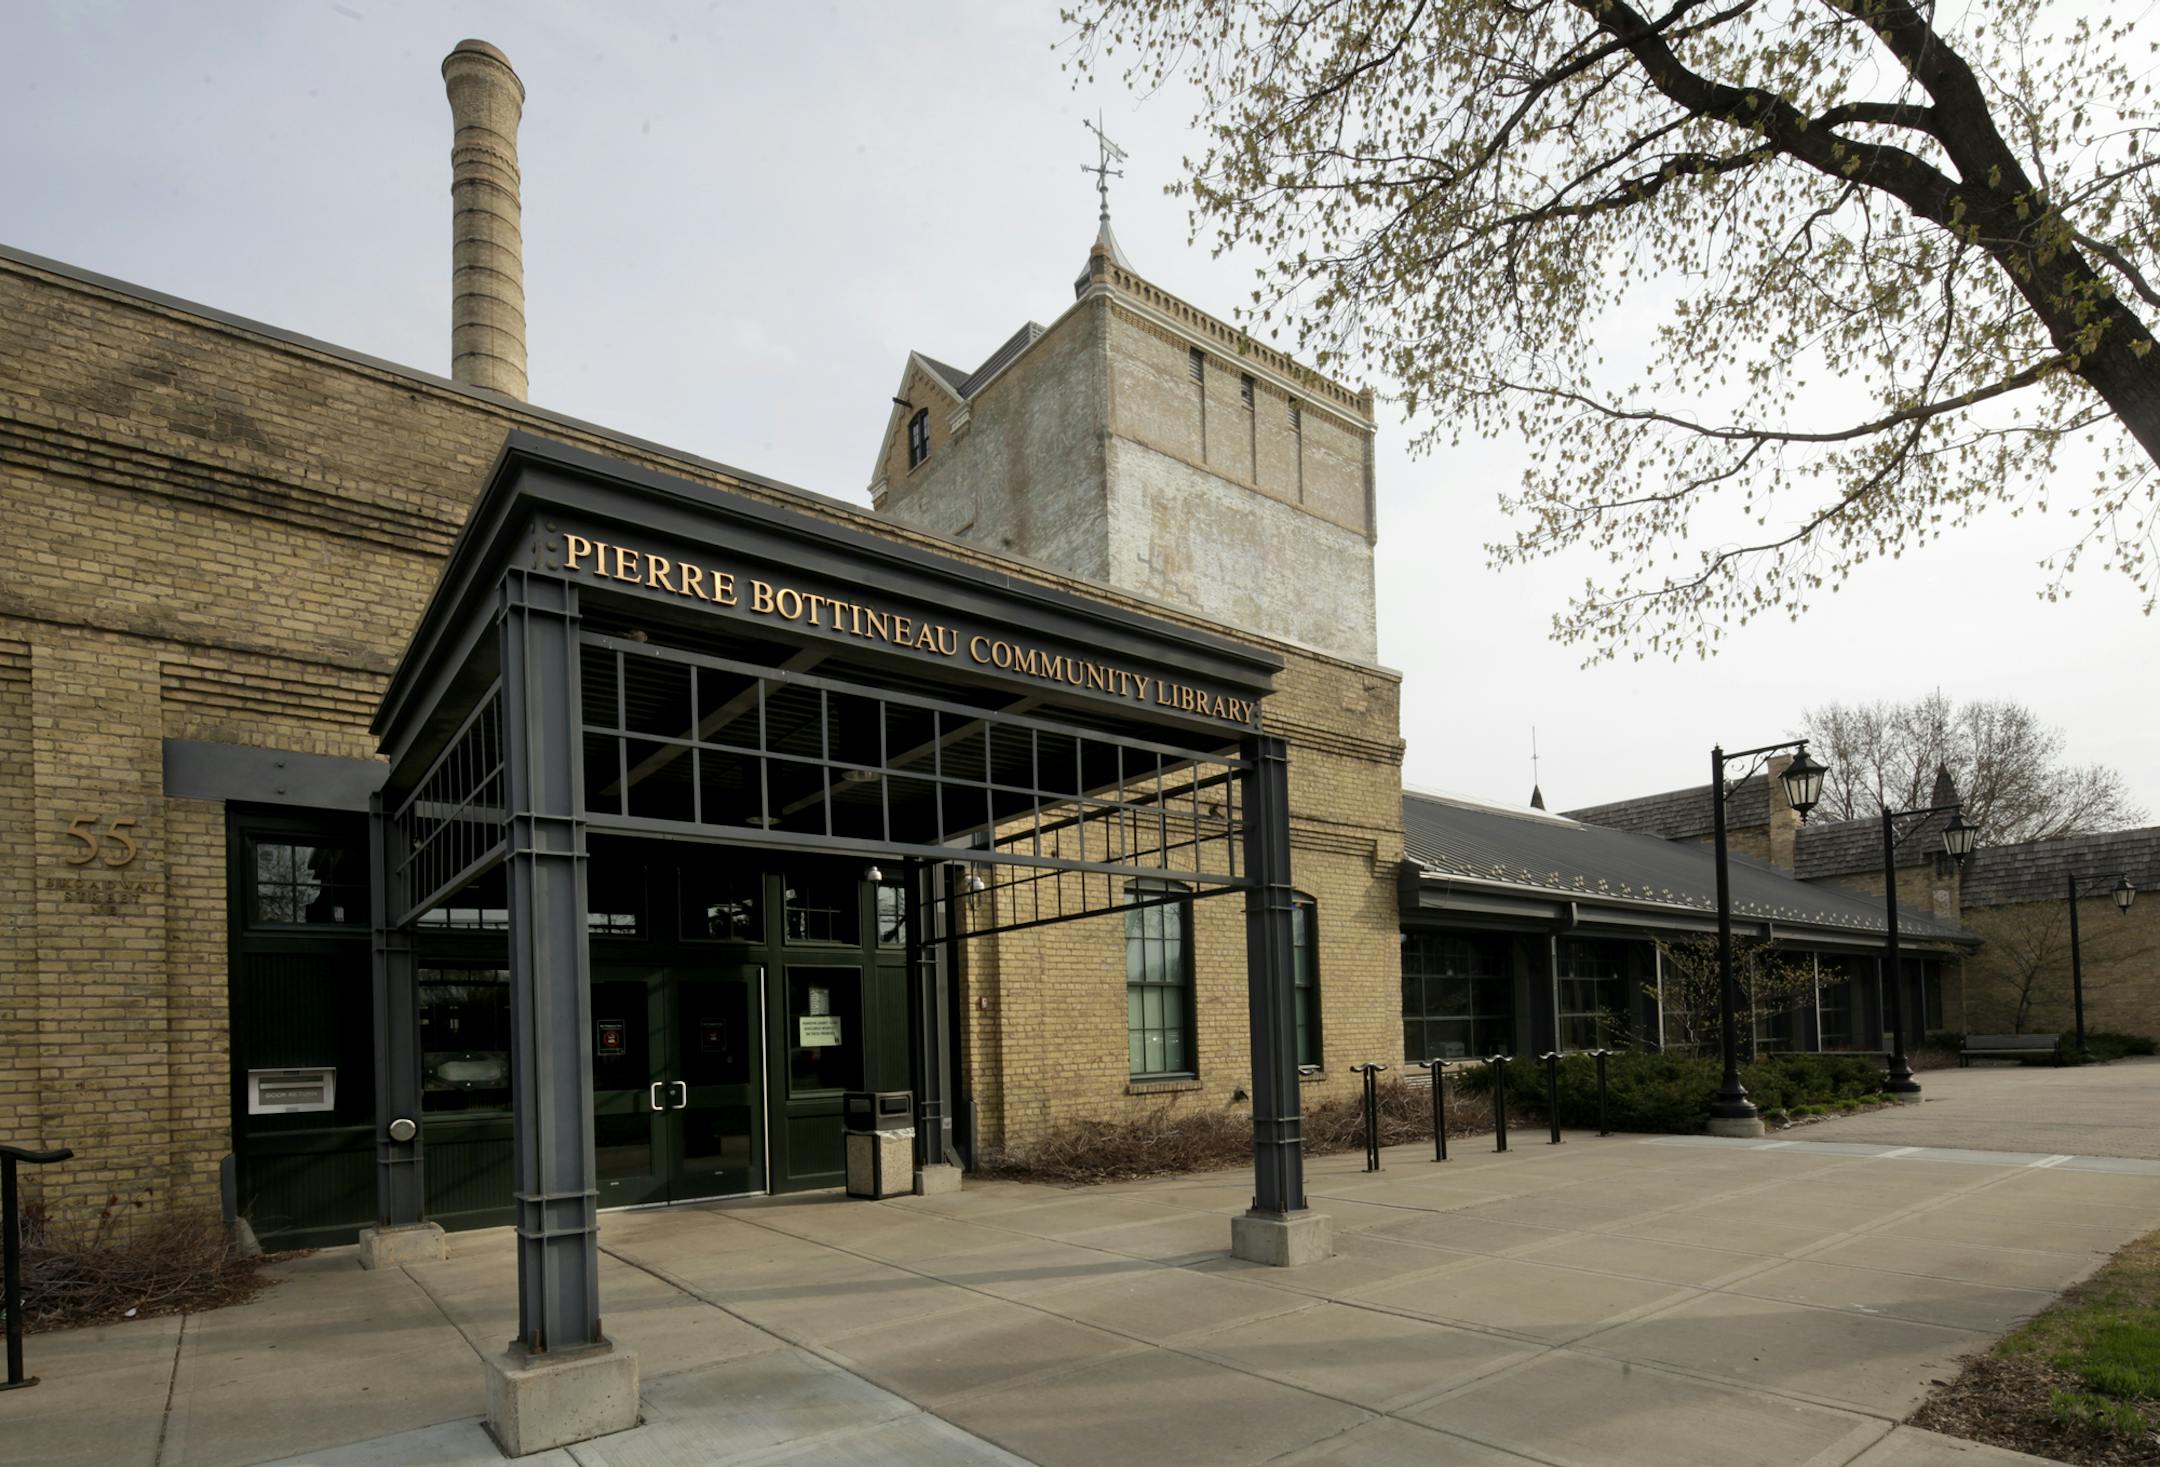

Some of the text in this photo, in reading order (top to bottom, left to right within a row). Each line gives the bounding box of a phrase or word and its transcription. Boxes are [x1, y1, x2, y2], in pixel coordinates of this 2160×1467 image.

[563, 533, 1255, 724] PIERRE BOTTINEAU COMMUNITY LIBRARY
[65, 815, 137, 867] 55
[45, 878, 159, 894] BROADWAY
[64, 891, 141, 905] STREET
